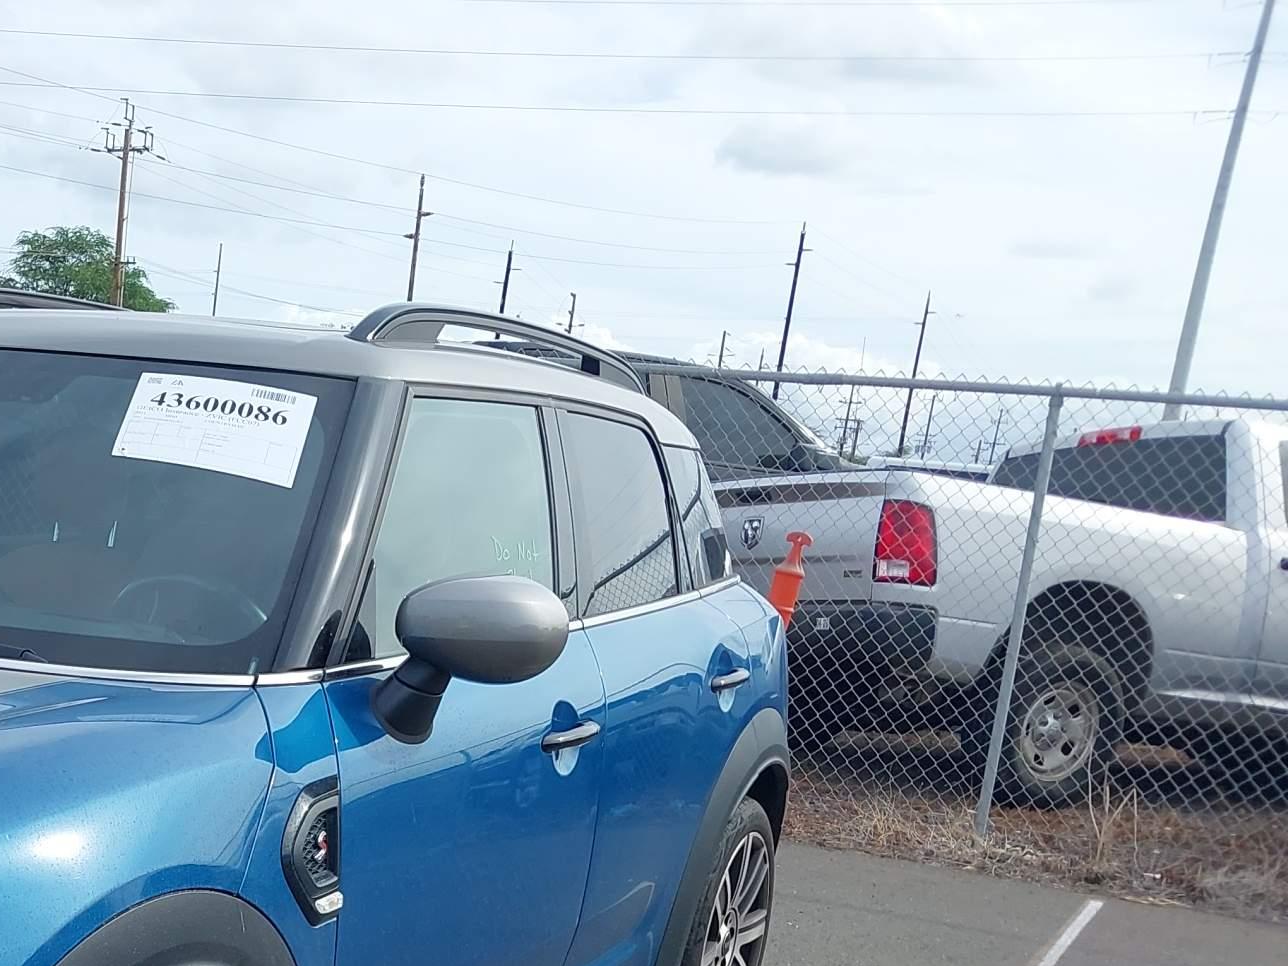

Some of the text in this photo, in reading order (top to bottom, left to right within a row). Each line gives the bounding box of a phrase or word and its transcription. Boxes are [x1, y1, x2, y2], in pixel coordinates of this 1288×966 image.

[150, 391, 289, 426] 43600086
[491, 535, 538, 561] Do Not
